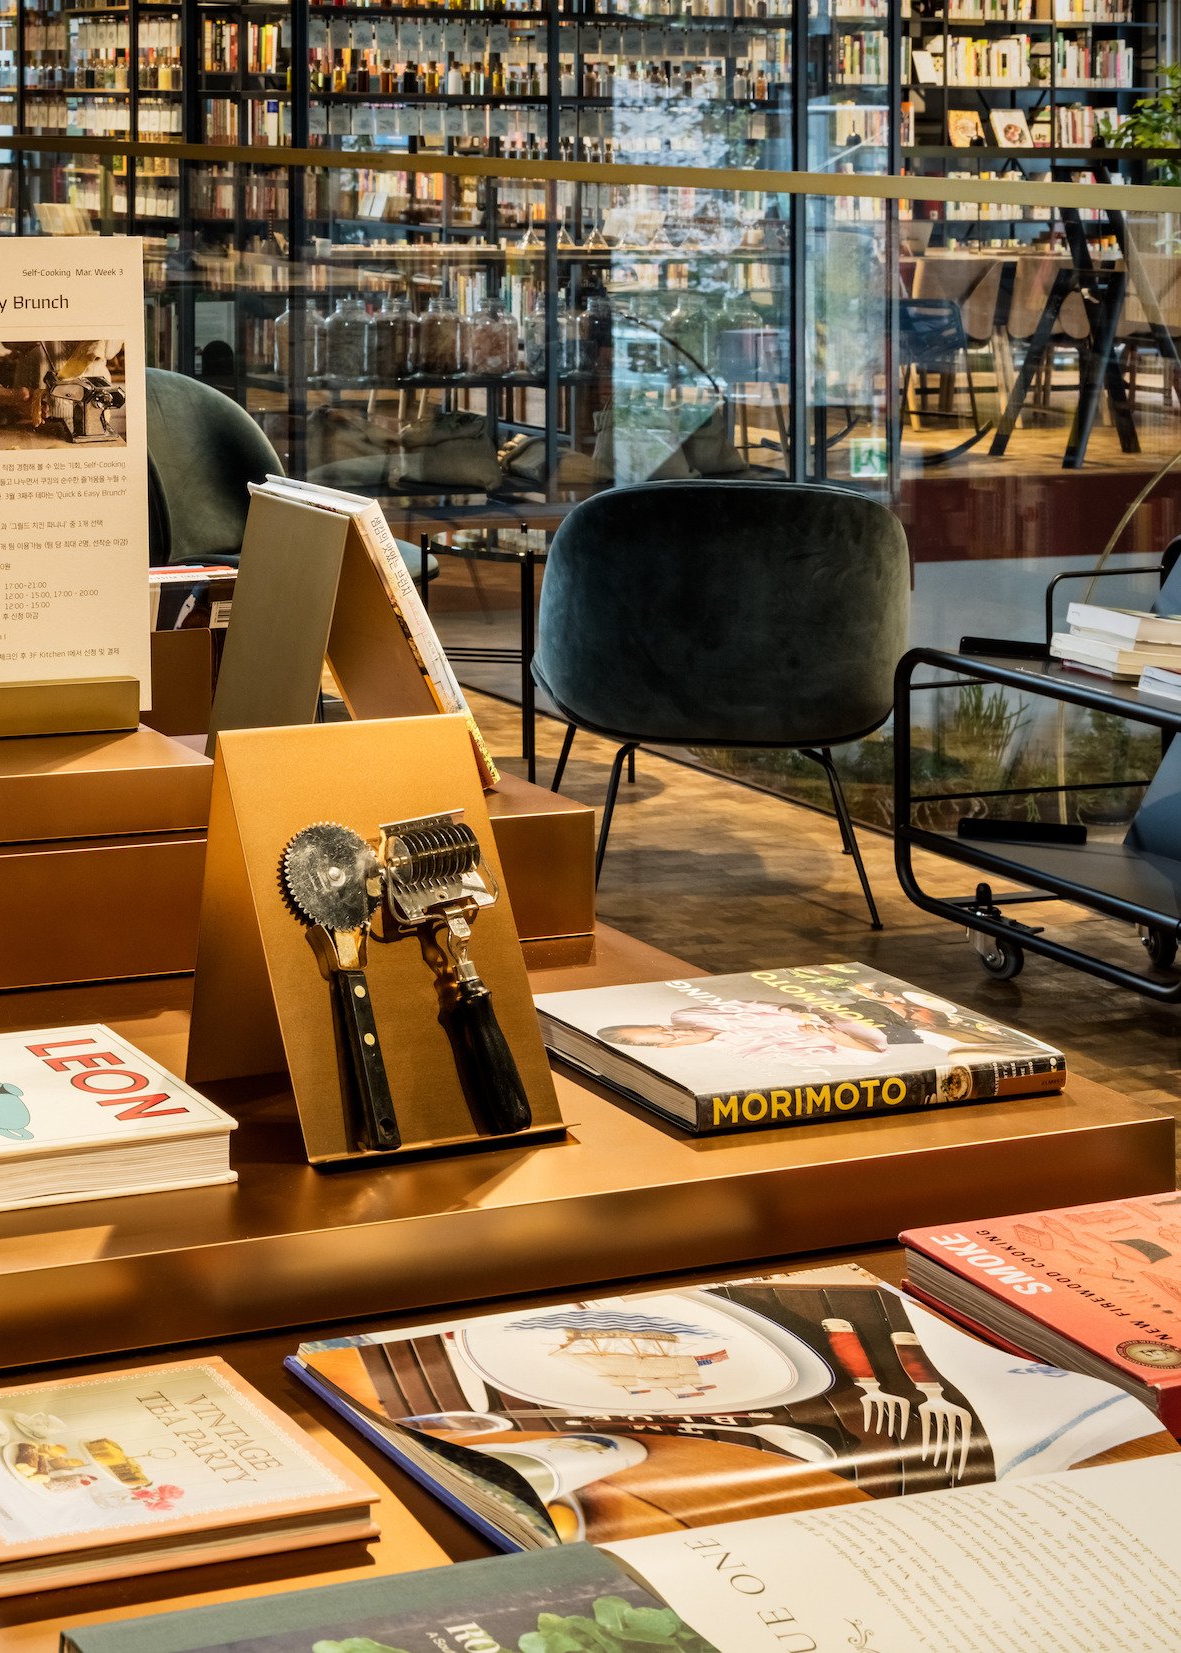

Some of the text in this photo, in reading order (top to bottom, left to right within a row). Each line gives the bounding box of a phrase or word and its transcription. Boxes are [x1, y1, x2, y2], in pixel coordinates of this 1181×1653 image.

[22, 269, 71, 278] Self-Cooking
[94, 268, 117, 276] Week
[119, 268, 124, 276] 3
[13, 294, 70, 310] Brunch
[84, 461, 126, 469] Self-Cooking
[84, 490, 100, 498] Easy
[4, 593, 24, 601] 12:00
[54, 590, 73, 598] 17:00
[79, 589, 99, 597] 20:00
[394, 568, 413, 597] 브런치
[25, 611, 39, 620] 마감
[31, 601, 50, 609] 15:00
[750, 971, 886, 1028] MORIMOTO
[25, 1038, 191, 1122] LEON
[712, 1076, 908, 1126] MORIMOTO
[930, 1232, 1053, 1296] SMOKE
[976, 1229, 1174, 1341] NEW FIREWOOD COOKING
[134, 1389, 259, 1487] TEA PARTY
[184, 1392, 287, 1473] VINTAGE
[683, 1535, 766, 1595] ONE
